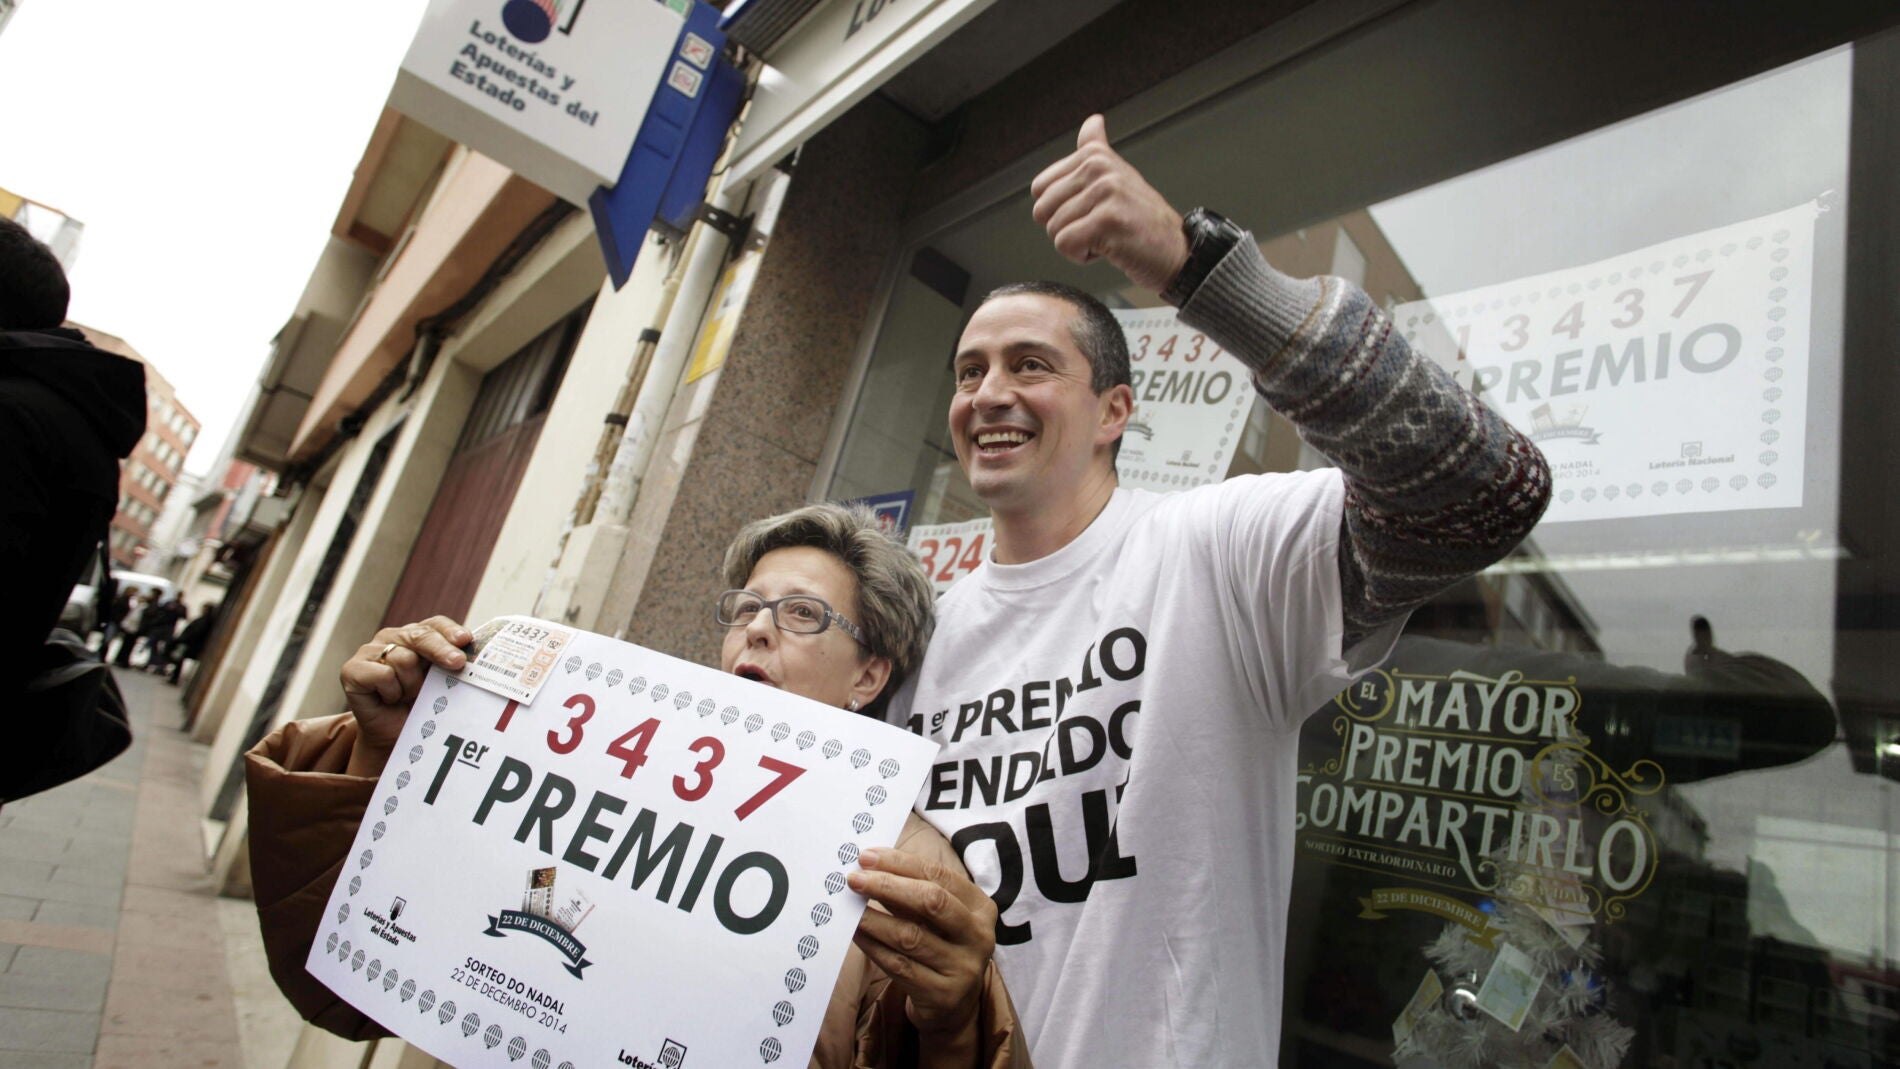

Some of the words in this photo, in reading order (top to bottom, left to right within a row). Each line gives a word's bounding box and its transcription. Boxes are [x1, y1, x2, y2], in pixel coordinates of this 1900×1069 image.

[469, 20, 556, 78] Loterías
[560, 76, 576, 91] y
[449, 60, 526, 111] Estado
[460, 42, 560, 106] Apuestas
[565, 102, 599, 126] del
[1131, 370, 1232, 405] REMIO
[1471, 323, 1741, 403] PREMIO
[1688, 453, 1736, 465] Nacional
[507, 623, 549, 640] 13437
[1360, 681, 1378, 701] EL
[1394, 669, 1576, 737] MAYOR
[925, 700, 1141, 811] ENDIDO
[1343, 723, 1524, 797] PREMIO
[1553, 764, 1575, 791] ES
[472, 756, 790, 935] PREMIO
[1304, 840, 1346, 857] SORTEO
[1347, 847, 1457, 878] EXTRAORDINARIO
[370, 925, 381, 936] del
[379, 929, 400, 946] Estado
[390, 922, 417, 943] Apuestas
[502, 913, 513, 925] 22
[514, 914, 529, 927] DE
[530, 919, 580, 959] DICIEMBRE
[1376, 892, 1389, 904] 22
[1391, 892, 1408, 904] DE
[1410, 893, 1482, 927] DICIEMBRE
[450, 968, 466, 985] 22
[465, 976, 479, 991] DE
[480, 981, 537, 1019] DECEMBRO
[538, 1012, 568, 1034] 2014
[464, 957, 505, 985] SORTEO
[507, 978, 525, 994] DO
[526, 987, 564, 1015] NADAL
